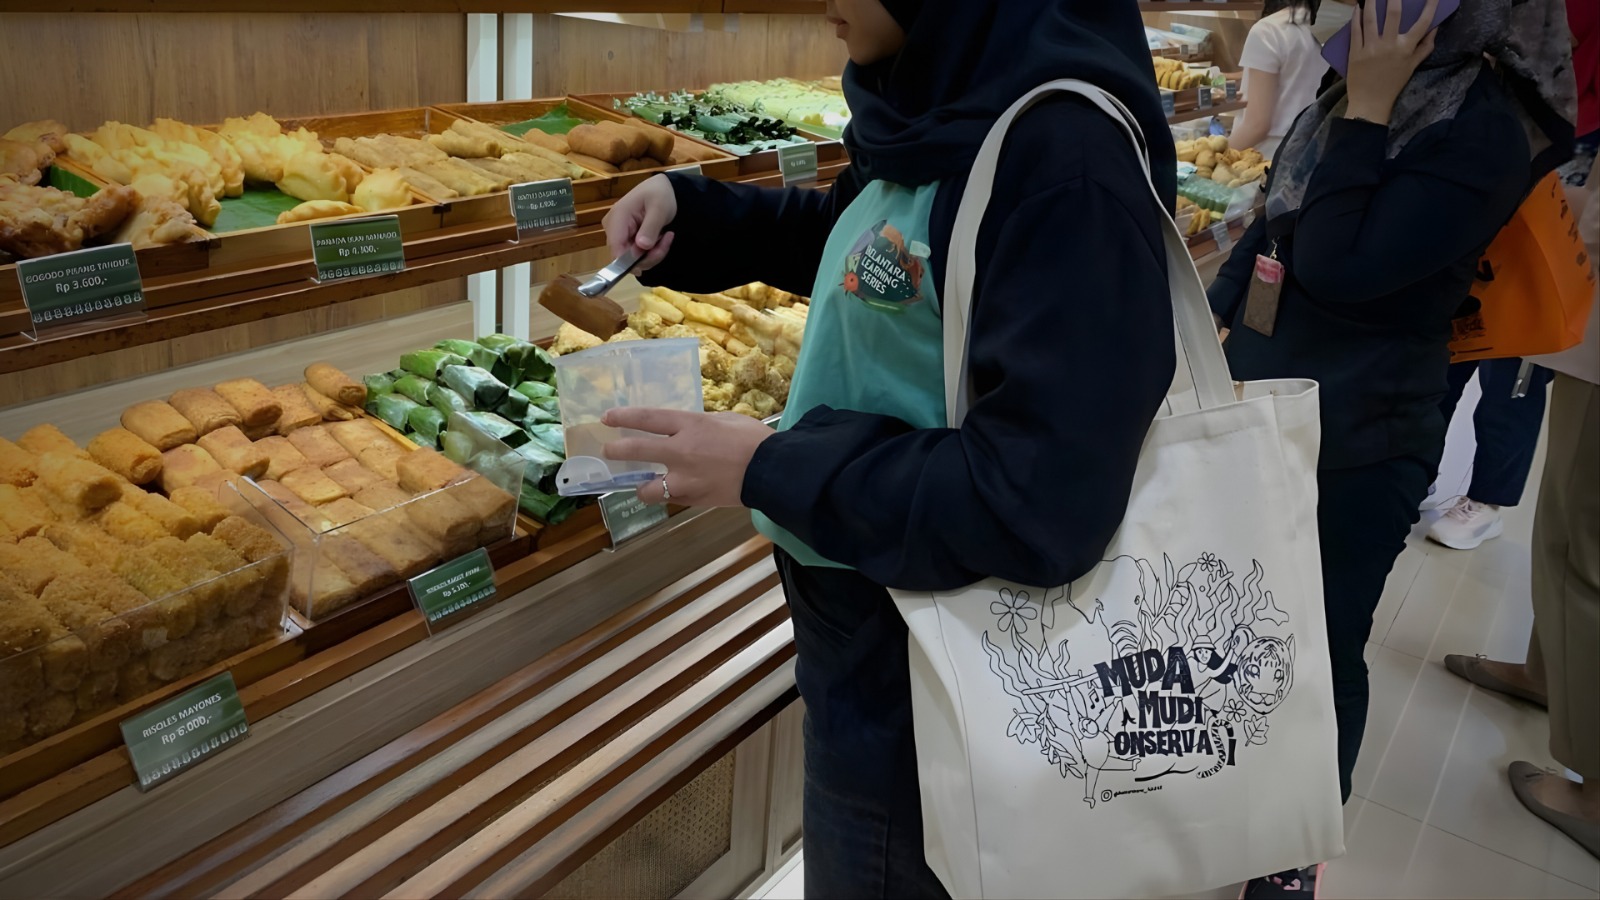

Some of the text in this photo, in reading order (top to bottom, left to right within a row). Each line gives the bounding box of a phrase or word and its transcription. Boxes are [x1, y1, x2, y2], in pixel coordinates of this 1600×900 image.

[56, 283, 70, 293] Rp
[861, 256, 899, 288] LEARNING
[861, 271, 887, 294] SERIES
[1094, 647, 1195, 697] MUDA
[142, 693, 222, 738] RISOLES MAYONES
[1138, 691, 1204, 729] MUDI
[161, 733, 176, 745] Rp
